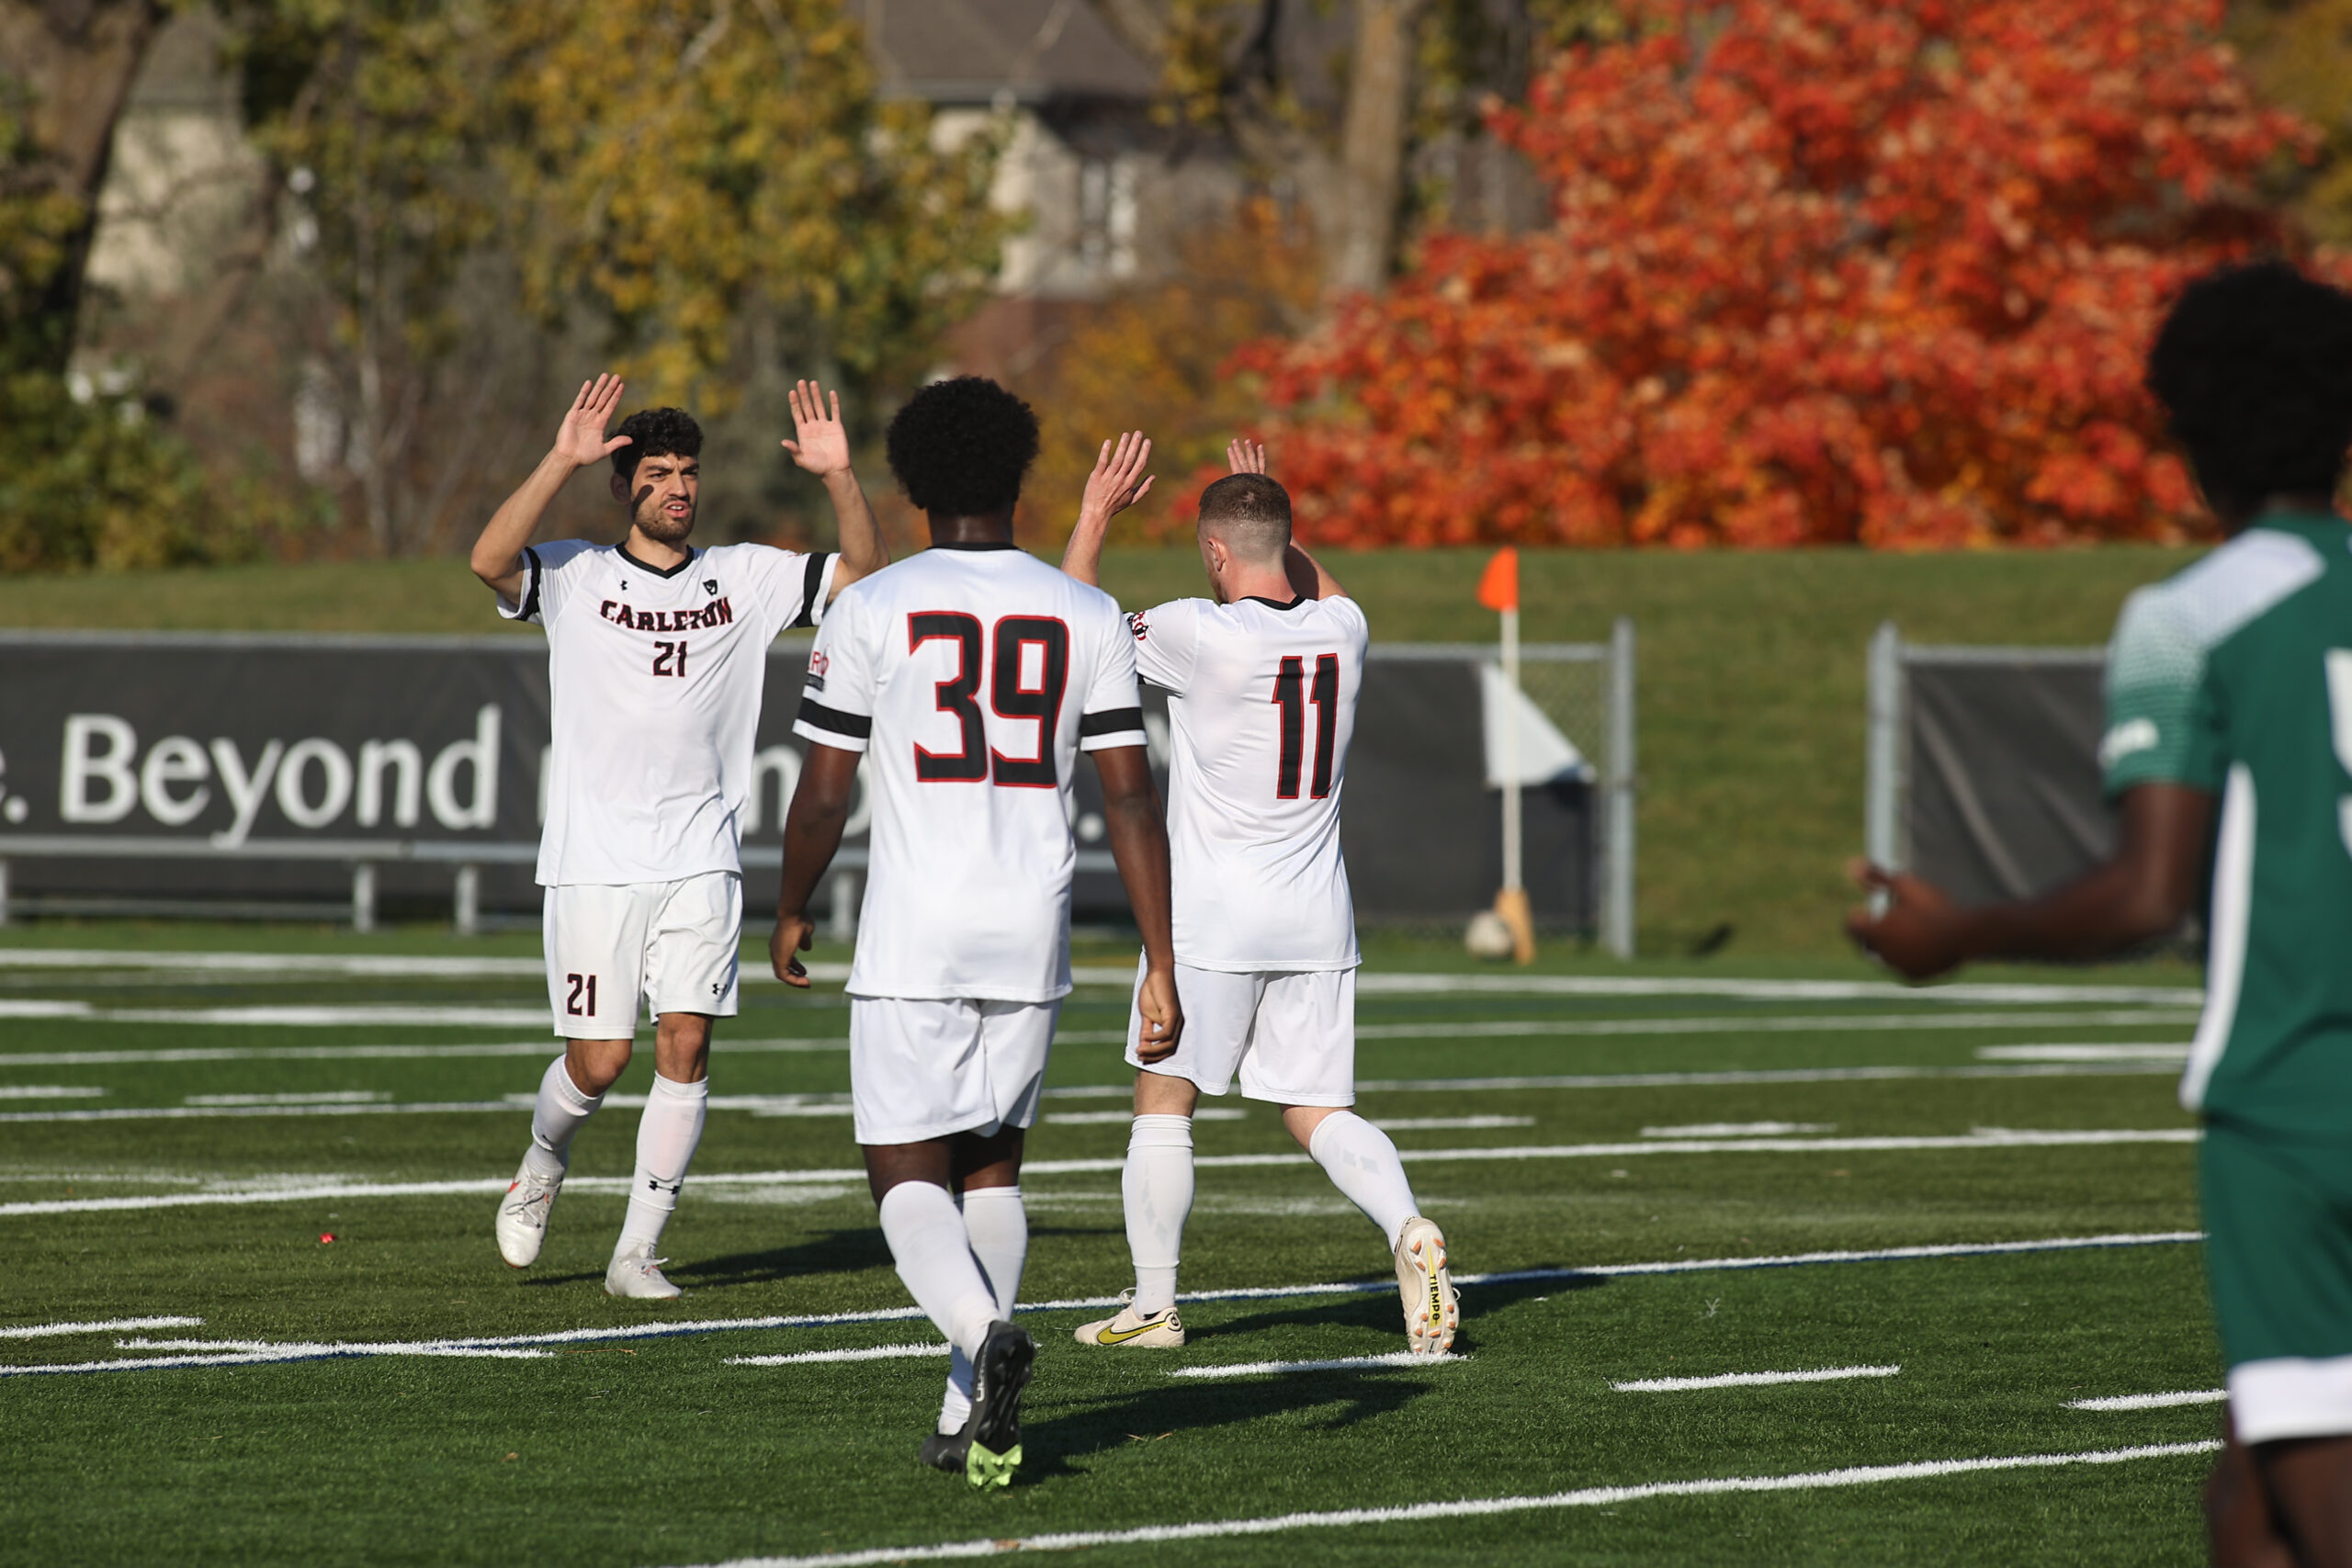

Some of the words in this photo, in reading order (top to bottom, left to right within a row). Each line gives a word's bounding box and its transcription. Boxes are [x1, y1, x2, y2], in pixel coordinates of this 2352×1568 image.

[600, 597, 733, 632] CARLETON
[652, 640, 687, 677] 21
[907, 610, 1069, 788] 39
[1272, 652, 1340, 799] 11
[60, 702, 503, 850] Beyond
[566, 972, 597, 1018] 21
[1430, 1274, 1441, 1321] TIEMPO
